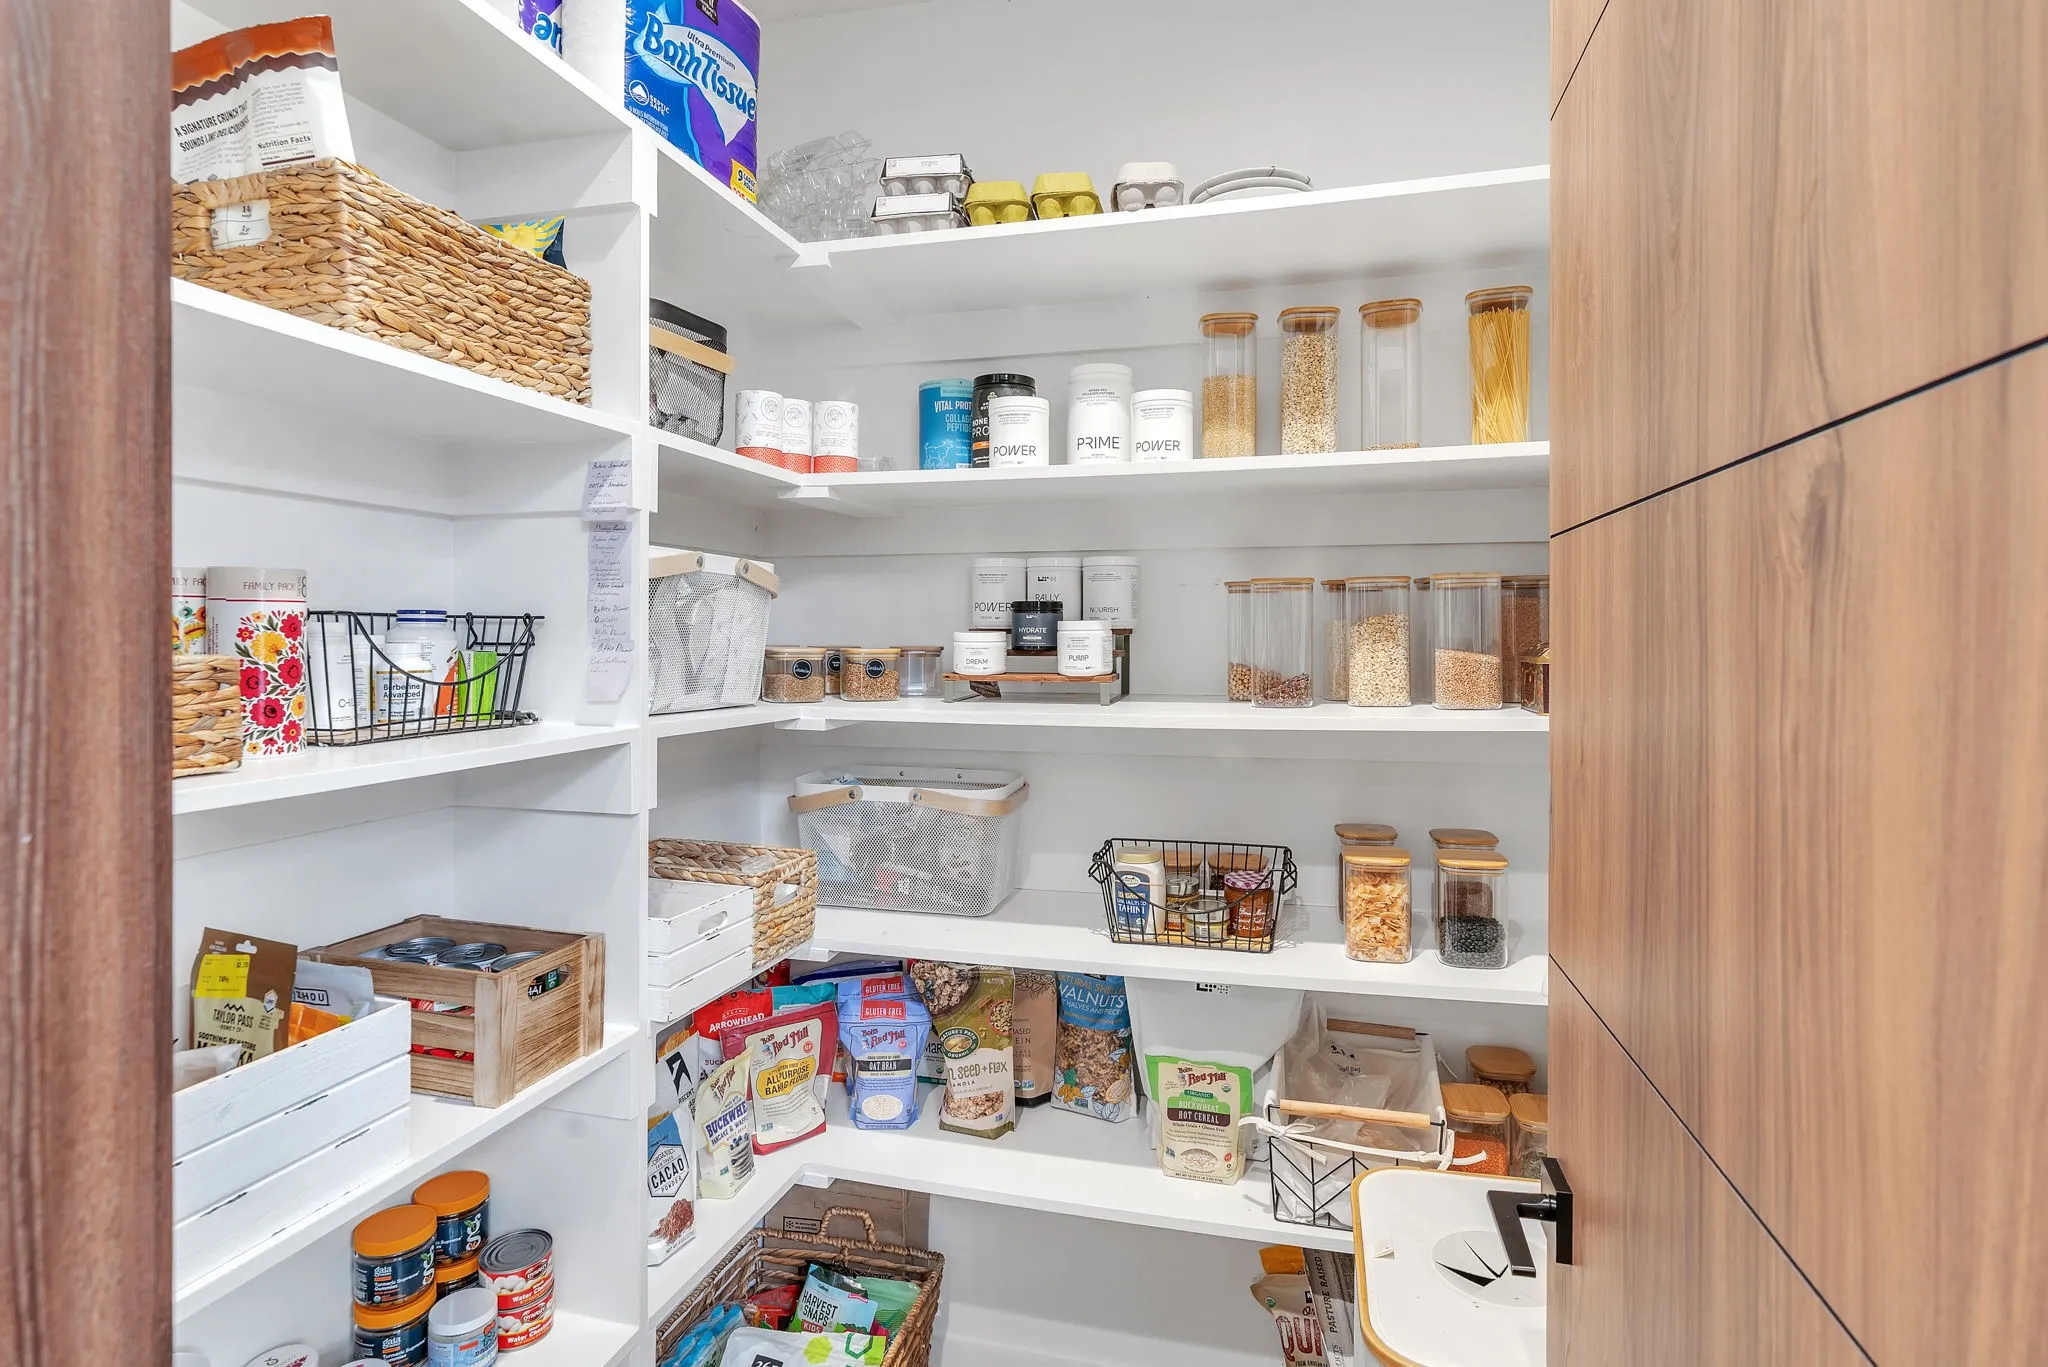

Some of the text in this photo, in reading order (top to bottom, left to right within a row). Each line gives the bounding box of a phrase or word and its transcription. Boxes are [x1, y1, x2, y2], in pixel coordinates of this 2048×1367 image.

[686, 30, 736, 70] Ultra Premium
[643, 13, 757, 120] Bath Tissue
[180, 115, 218, 136] SIGNATURE
[217, 108, 240, 125] CRUNCH
[180, 135, 206, 152] SOUNDS
[257, 135, 312, 149] Nutrition Facts
[738, 170, 743, 181] 9
[934, 401, 953, 413] VITAL
[1077, 436, 1120, 451] PRIME
[1135, 440, 1181, 453] POWER
[993, 445, 1037, 458] POWER
[243, 581, 296, 590] FAMILY PACK
[974, 602, 1012, 612] POWER
[965, 658, 989, 666] DREAM
[1068, 654, 1089, 662] PUMP
[383, 683, 420, 691] Brbeine
[383, 691, 421, 699] Avanced
[865, 982, 900, 993] GLUTEN FREE
[296, 991, 325, 1002] ZHOU
[865, 1008, 887, 1016] GLUTEN
[1066, 1000, 1090, 1011] HALVES
[212, 1009, 255, 1029] TAYLOR PASS
[709, 1013, 765, 1033] ARROWHEAD
[198, 1031, 227, 1044] SOOTHING
[228, 1037, 237, 1045] BY
[771, 1034, 789, 1057] Red
[789, 1025, 810, 1049] Mill
[870, 1032, 888, 1049] Red
[888, 1029, 906, 1045] Mill
[940, 1029, 977, 1042] NATURE'S PATH
[947, 1050, 970, 1059] ORGANIC
[869, 1061, 897, 1071] OAT BRAN
[1187, 1073, 1207, 1087] Red
[1207, 1072, 1226, 1085] Mill
[1187, 1090, 1210, 1098] ORGANIC
[1179, 1101, 1220, 1113] BUCKWHEAT
[1178, 1111, 1220, 1124] HOT CEREAL
[711, 1130, 729, 1147] PANCAKE
[652, 1148, 675, 1167] ORGANIC
[651, 1158, 685, 1189] CACAO
[661, 1175, 683, 1195] POWDER
[374, 1266, 392, 1277] gaia
[374, 1271, 420, 1288] Turmeric Supreme
[512, 1292, 532, 1302] Water
[1314, 1257, 1338, 1333] PASTURE RAISED
[802, 1290, 838, 1319] HARVEST
[803, 1305, 829, 1327] SNAPS
[803, 1322, 821, 1333] KIDS
[382, 1336, 401, 1349] gaia
[507, 1334, 527, 1344] Water
